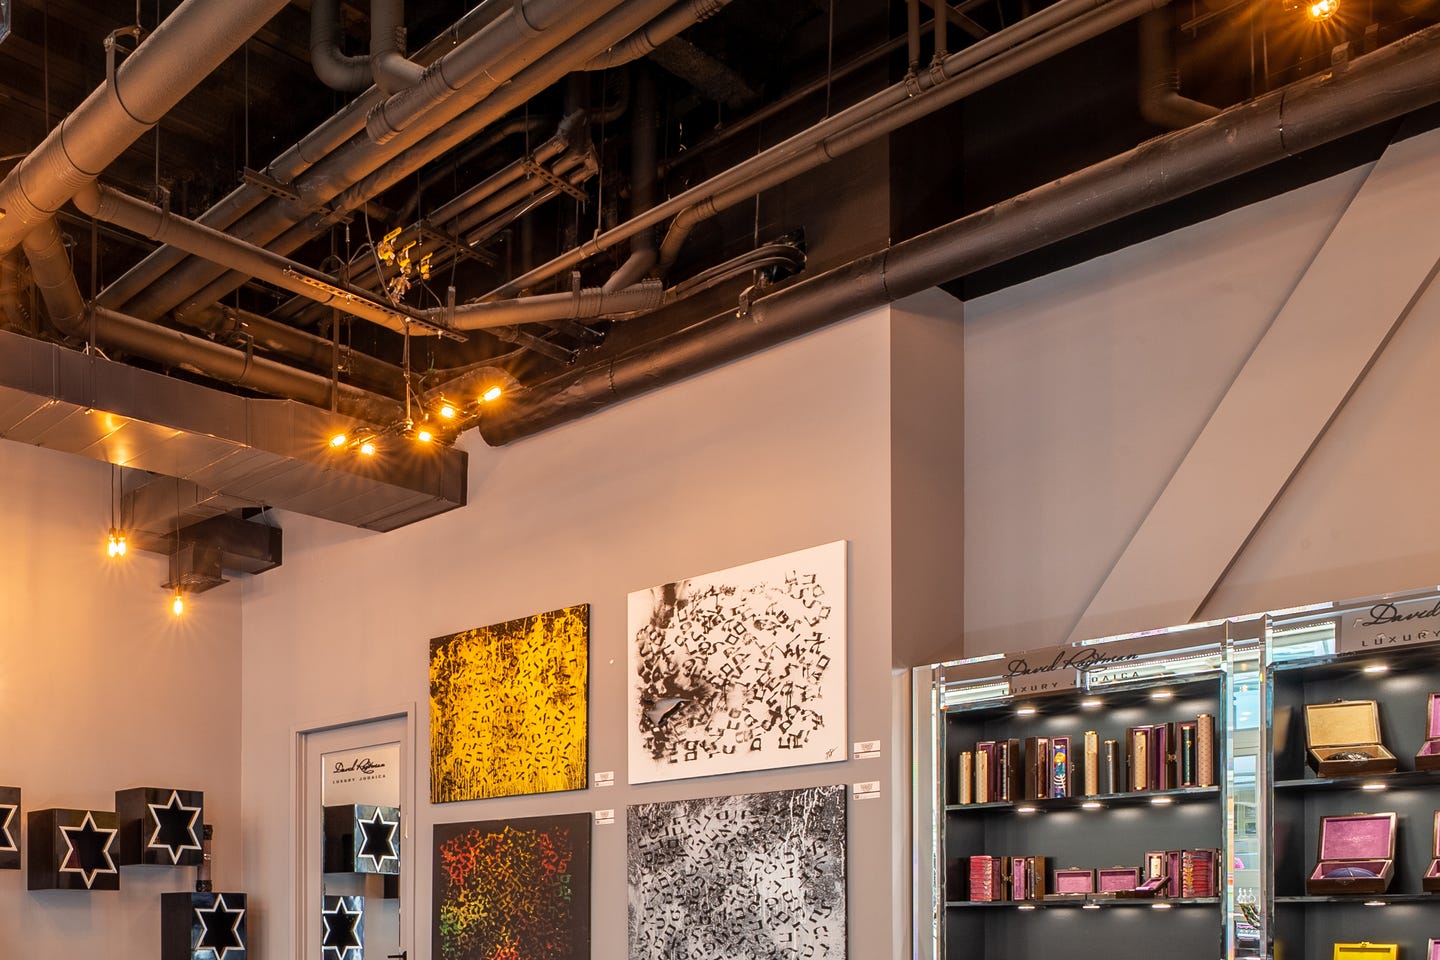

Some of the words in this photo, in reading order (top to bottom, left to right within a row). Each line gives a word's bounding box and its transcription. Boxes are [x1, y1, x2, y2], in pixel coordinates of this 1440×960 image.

[1362, 601, 1440, 627] David
[1362, 630, 1440, 647] LUXURY
[1002, 650, 1065, 678] David
[1002, 681, 1058, 695] LUXURY
[333, 758, 358, 774] David
